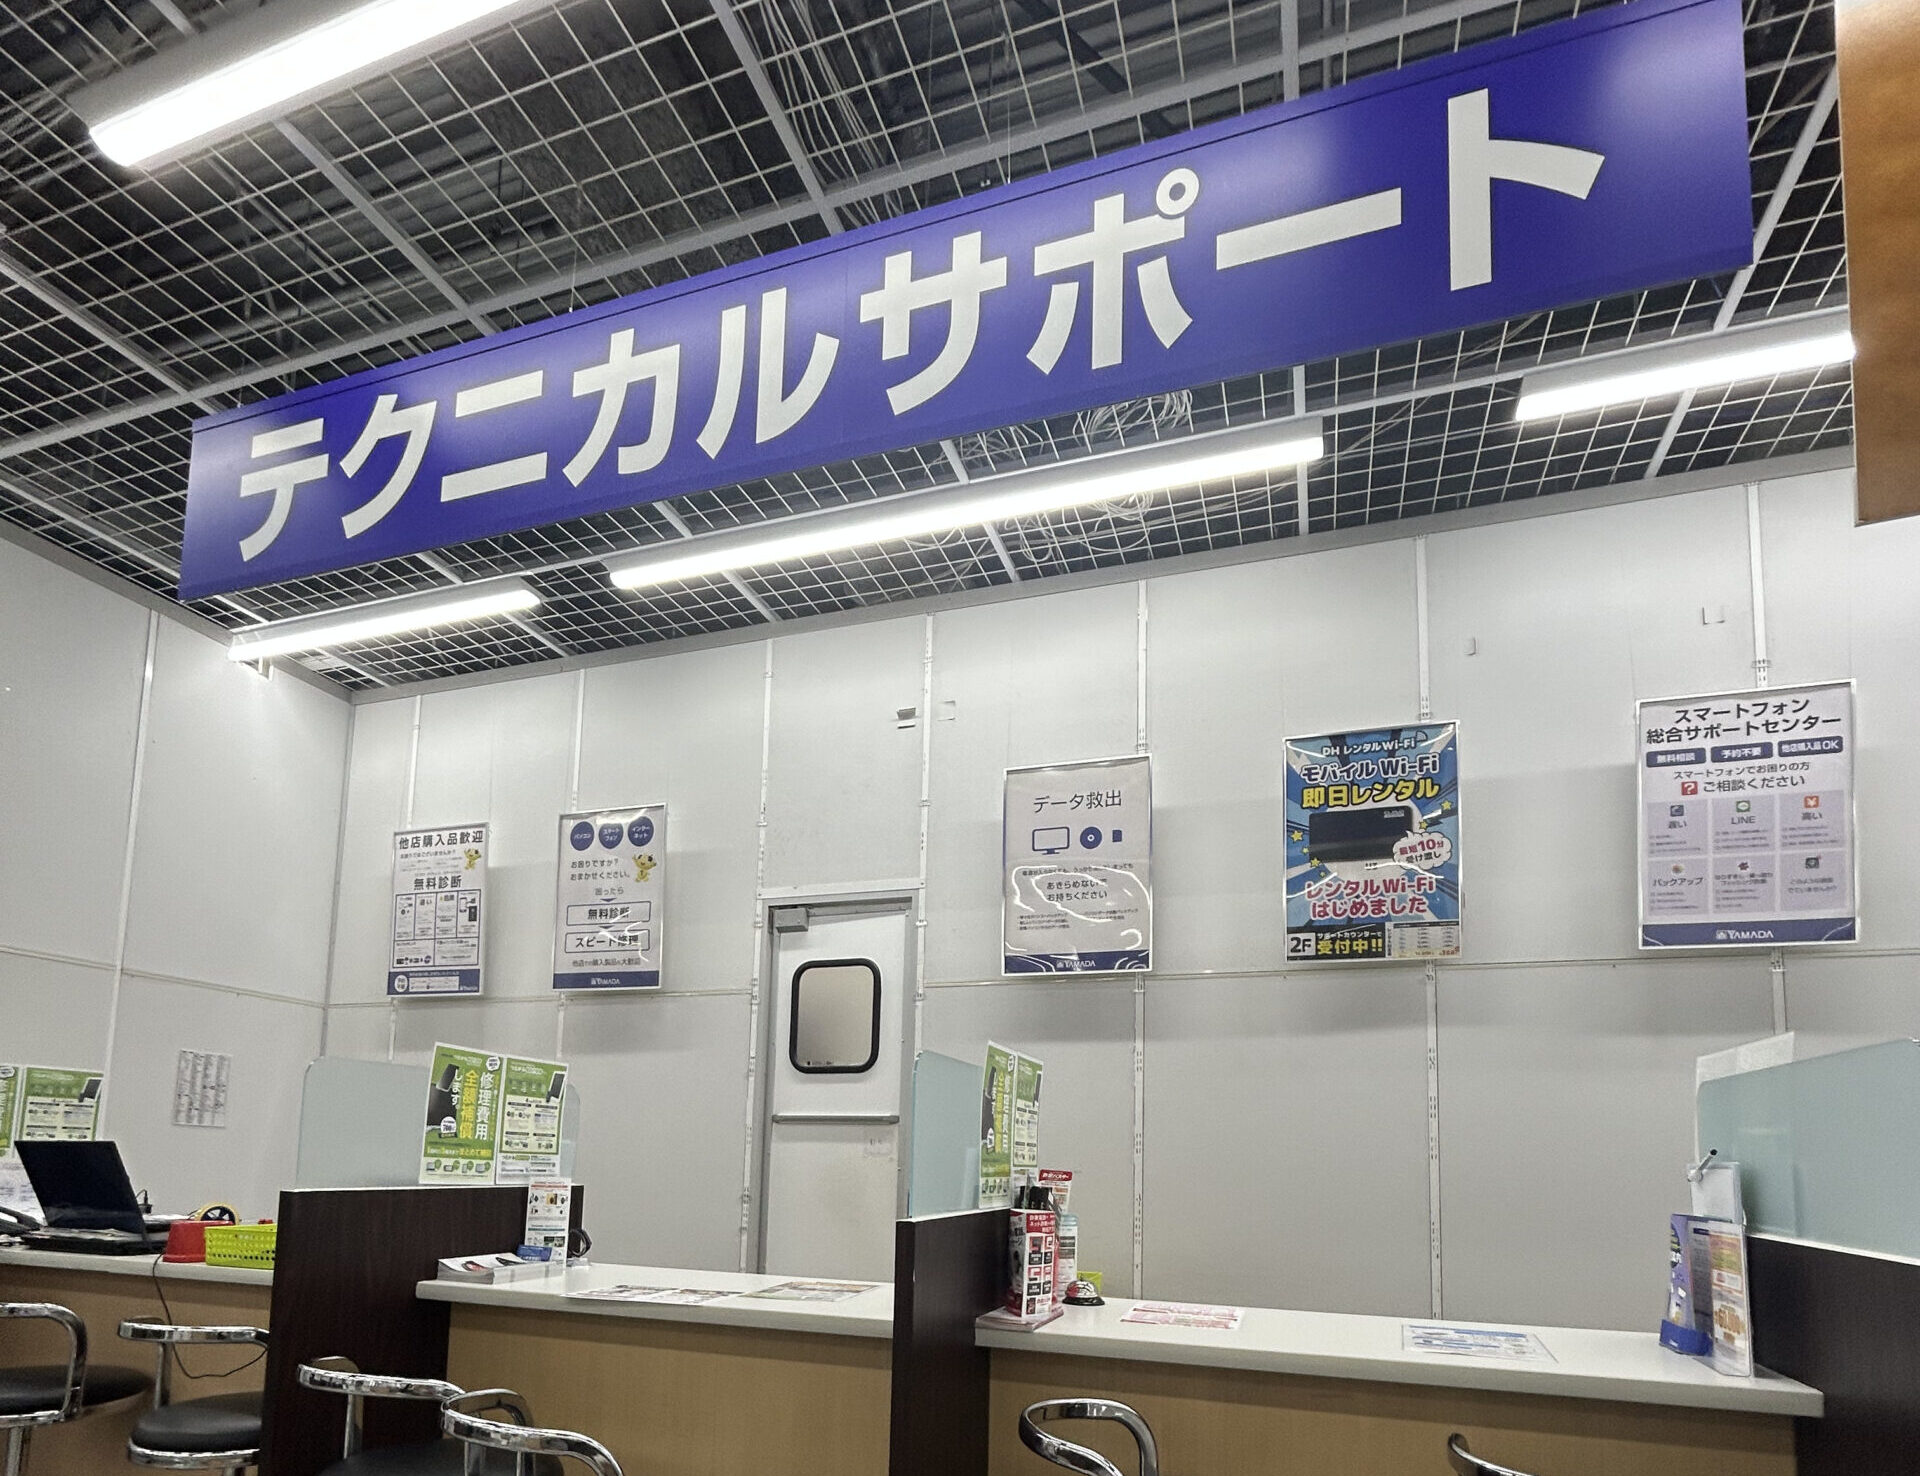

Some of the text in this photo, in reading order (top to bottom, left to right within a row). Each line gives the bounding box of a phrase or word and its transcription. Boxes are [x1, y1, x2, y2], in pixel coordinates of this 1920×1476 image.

[238, 88, 1606, 563] テクニカルサポート
[1675, 699, 1810, 724] スマートフォン
[1646, 715, 1842, 744] 総合サポートセンター
[1322, 737, 1416, 757] DH レンタルWi-Fi
[1673, 761, 1810, 780] スマートフォンでお困りの方
[1301, 777, 1440, 809] 即日レンタル
[1703, 775, 1806, 794] ご相談ください
[1033, 789, 1122, 813] データ救出
[1731, 816, 1756, 825] LINE
[399, 830, 484, 850] 他店購入品歓迎
[413, 875, 462, 891] 無料診断
[1304, 875, 1436, 899] レンタルWi-Fi
[1652, 877, 1704, 887] バックアップ
[1047, 890, 1108, 902] お持ちください
[587, 906, 630, 920] 無料診断
[1310, 895, 1429, 921] はじめました
[575, 934, 639, 948] スピード修理
[1289, 936, 1312, 953] 2F
